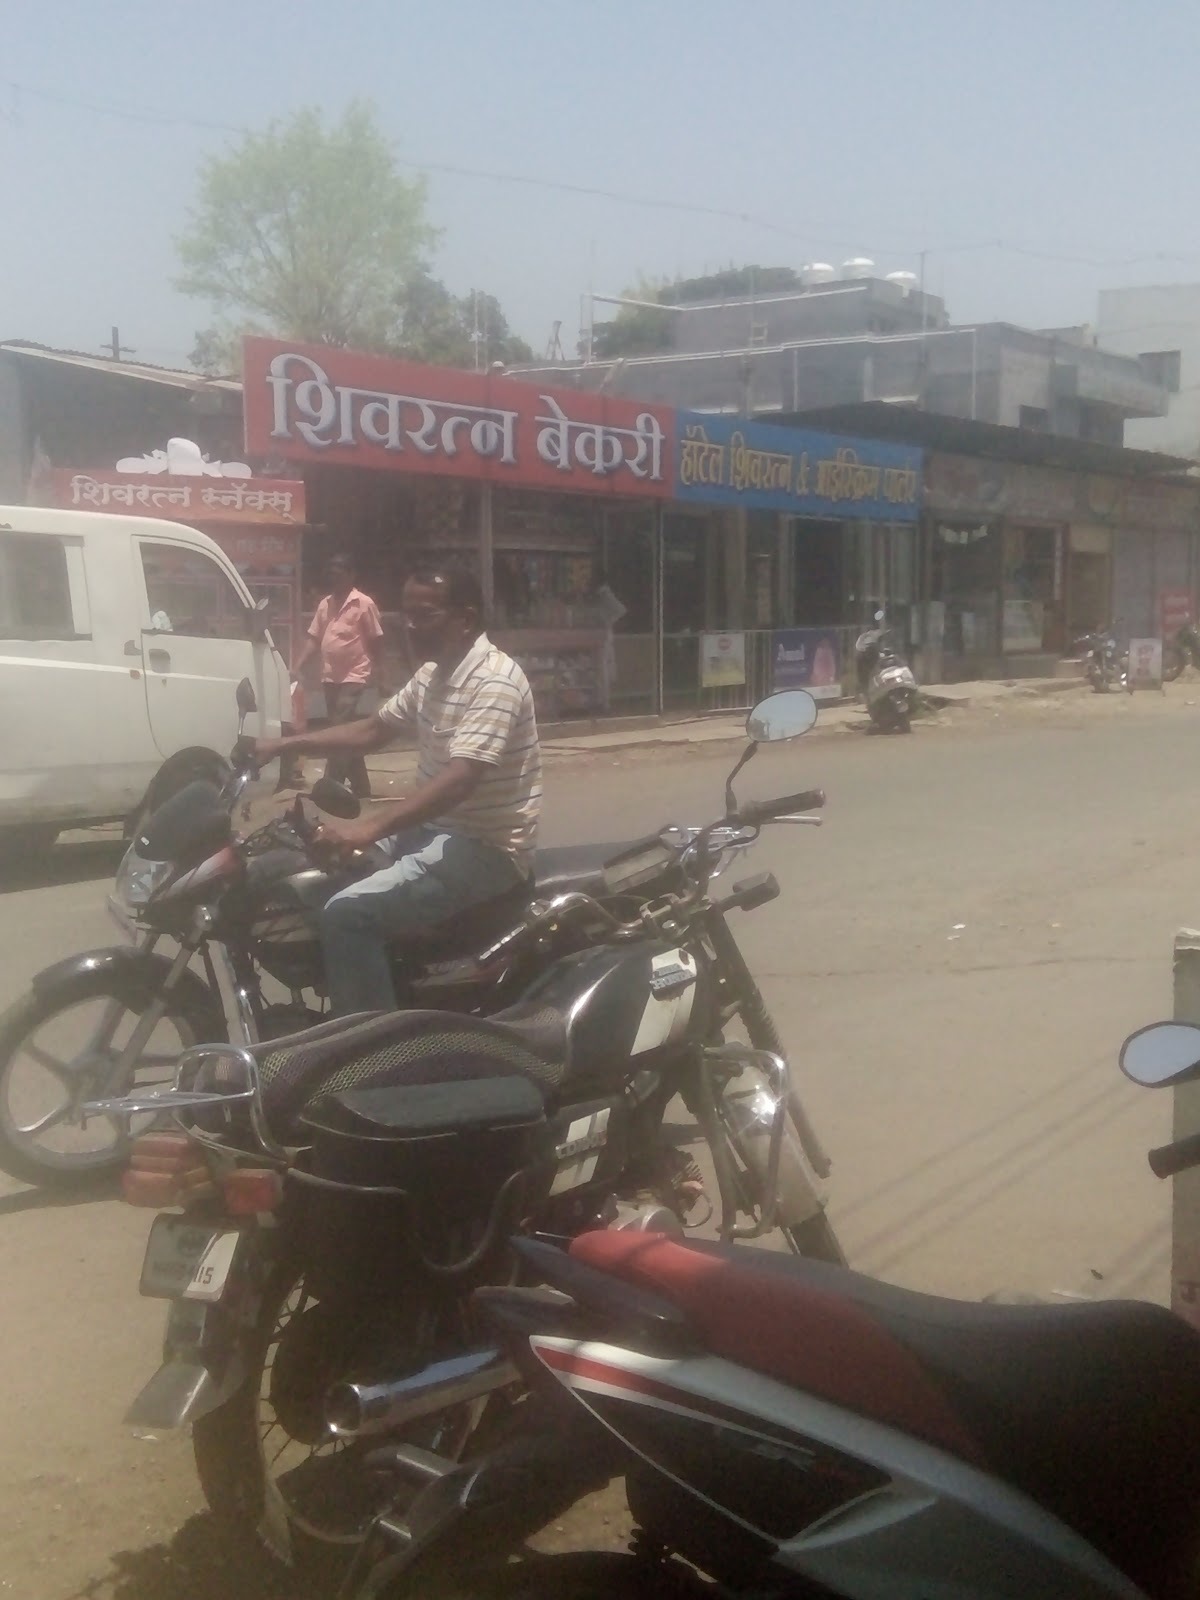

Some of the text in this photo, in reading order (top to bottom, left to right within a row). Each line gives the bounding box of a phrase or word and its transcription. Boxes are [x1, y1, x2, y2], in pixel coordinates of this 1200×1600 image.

[266, 353, 666, 481] शिवरत्न बेकरी
[70, 474, 192, 508] शिवरत्न
